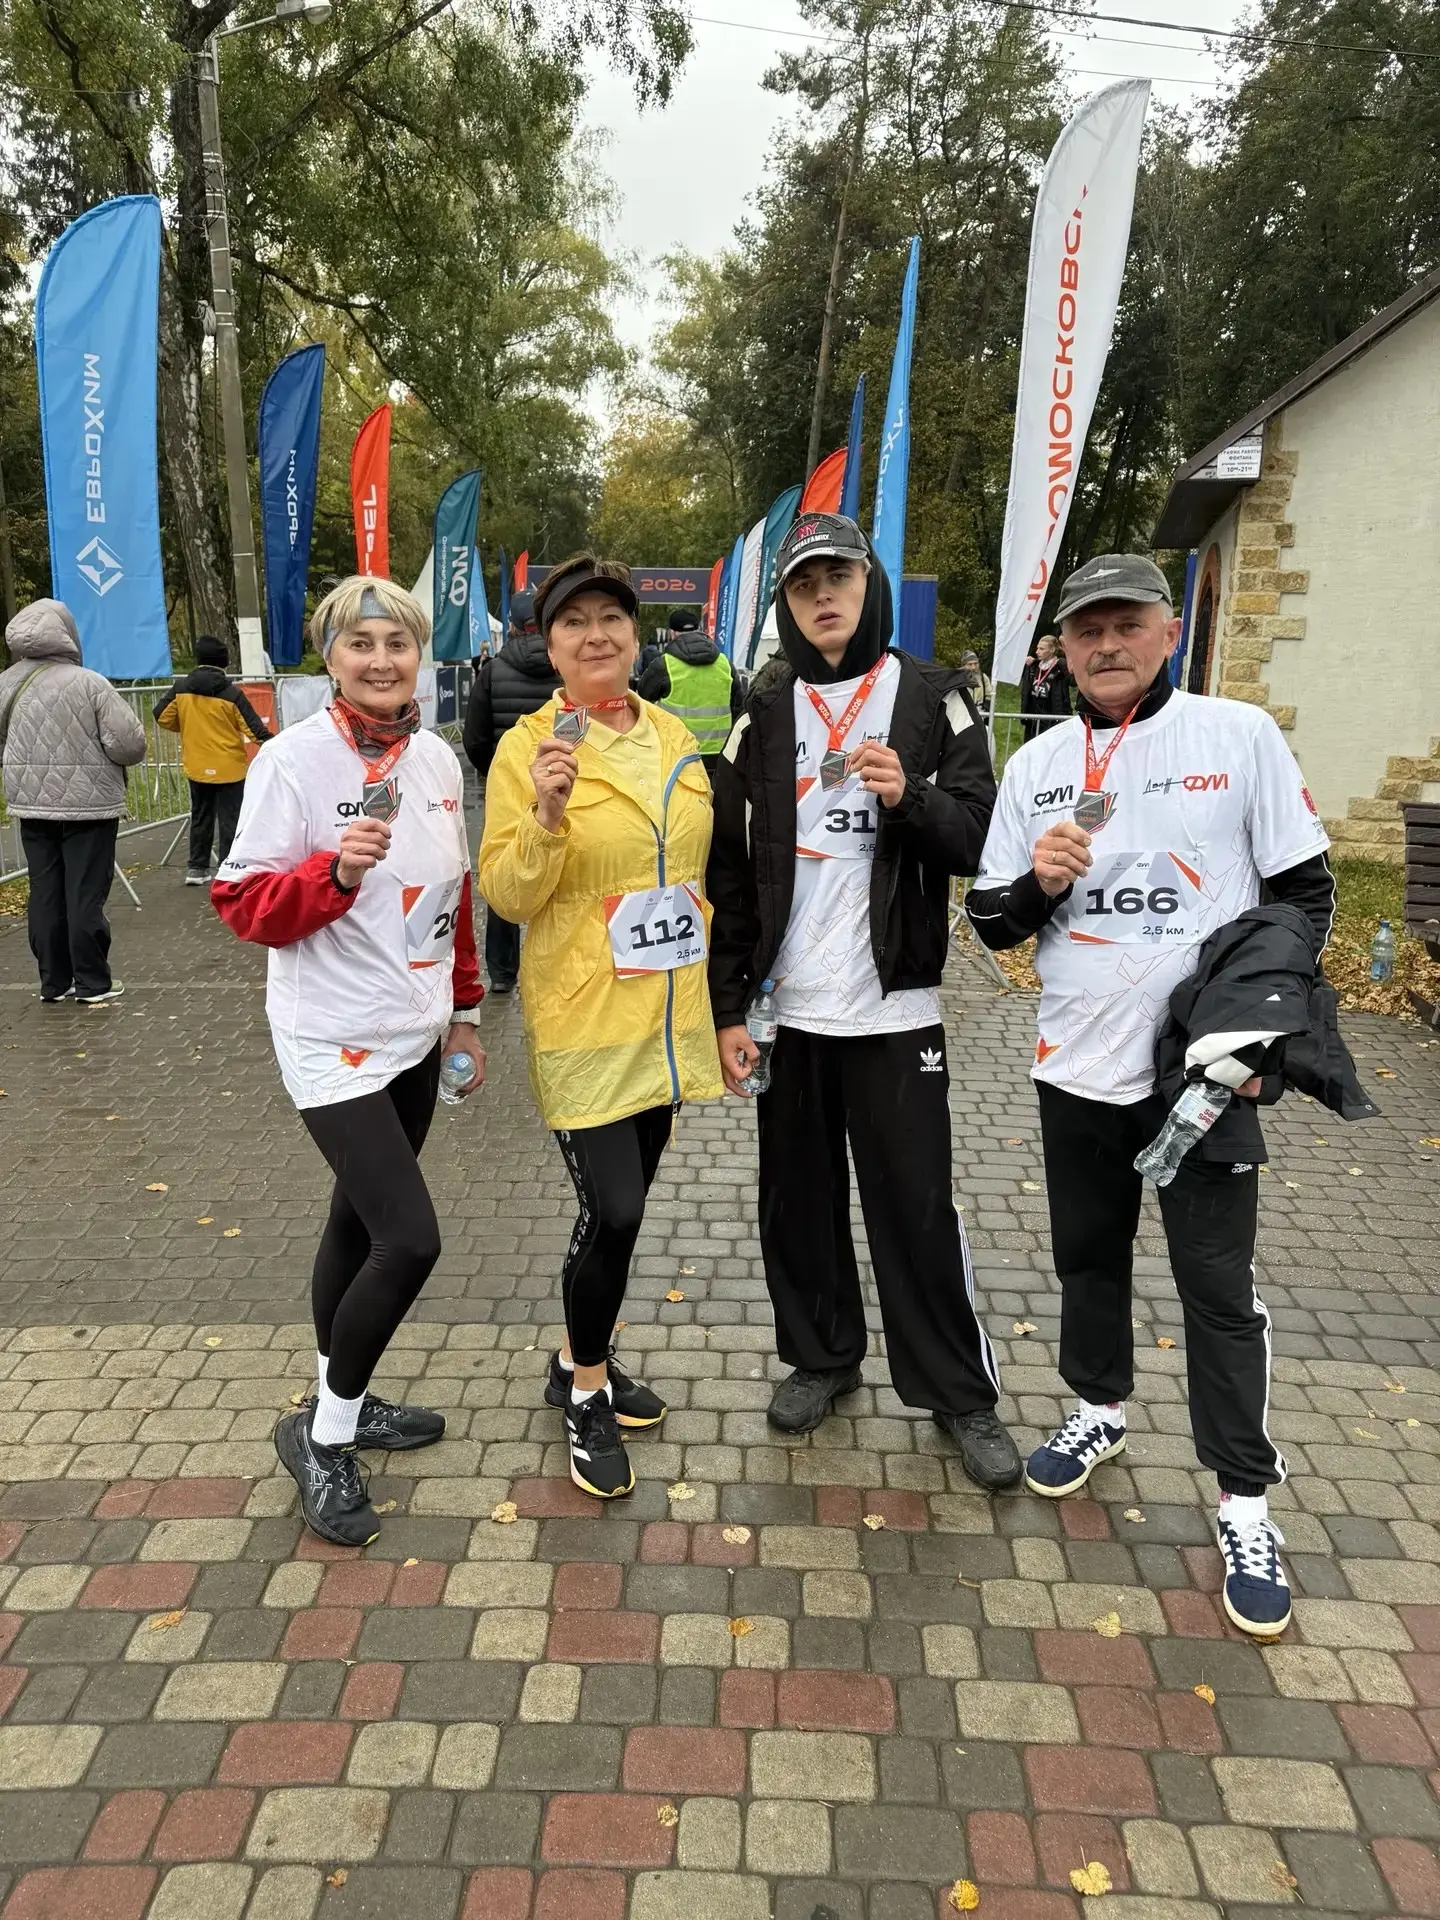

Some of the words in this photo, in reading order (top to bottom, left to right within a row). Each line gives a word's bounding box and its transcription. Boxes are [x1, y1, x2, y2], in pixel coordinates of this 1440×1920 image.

[640, 578, 696, 592] 2026
[850, 698, 864, 715] 2026
[825, 809, 876, 833] 31
[1086, 887, 1179, 915] 166
[630, 914, 695, 950] 112
[1142, 926, 1163, 936] 2,5
[676, 948, 691, 959] 2,5
